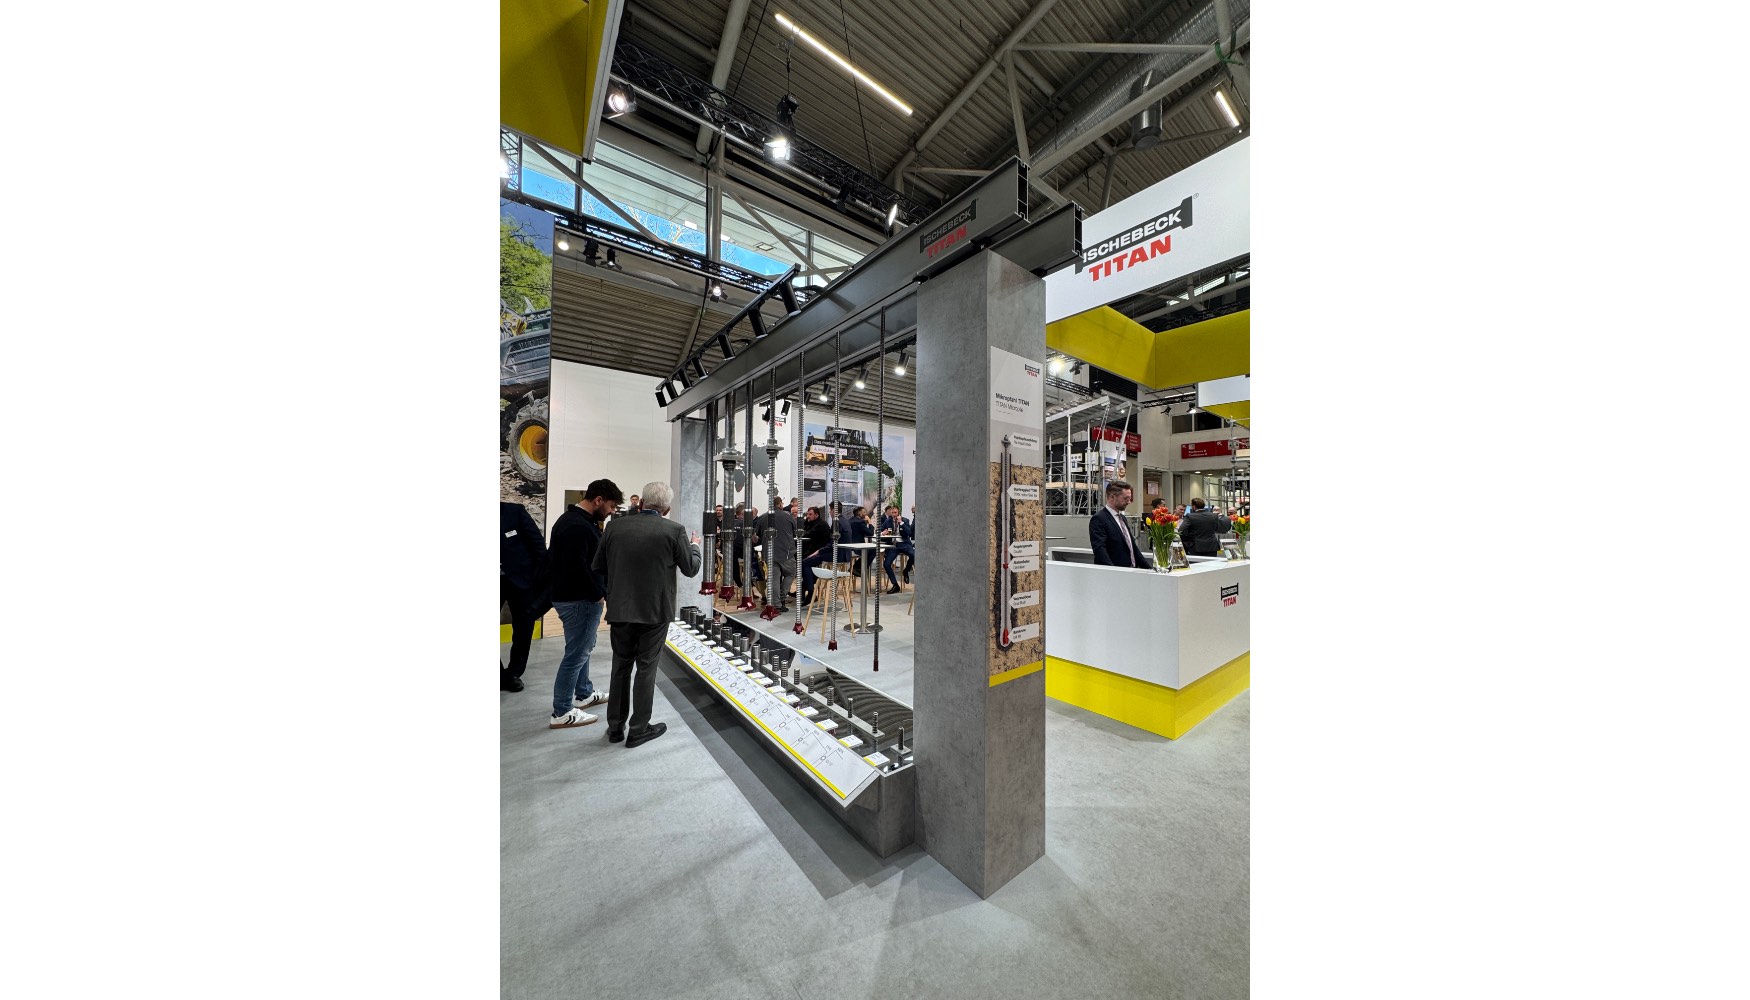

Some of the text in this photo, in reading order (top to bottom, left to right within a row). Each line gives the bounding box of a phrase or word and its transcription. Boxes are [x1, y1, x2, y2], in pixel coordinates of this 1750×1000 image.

[923, 208, 972, 246] ISCHEBECK
[927, 223, 969, 259] TITAN
[1083, 209, 1182, 264] ISCHEBECK
[1088, 234, 1172, 282] TITAN
[1223, 596, 1237, 608] TITAN
